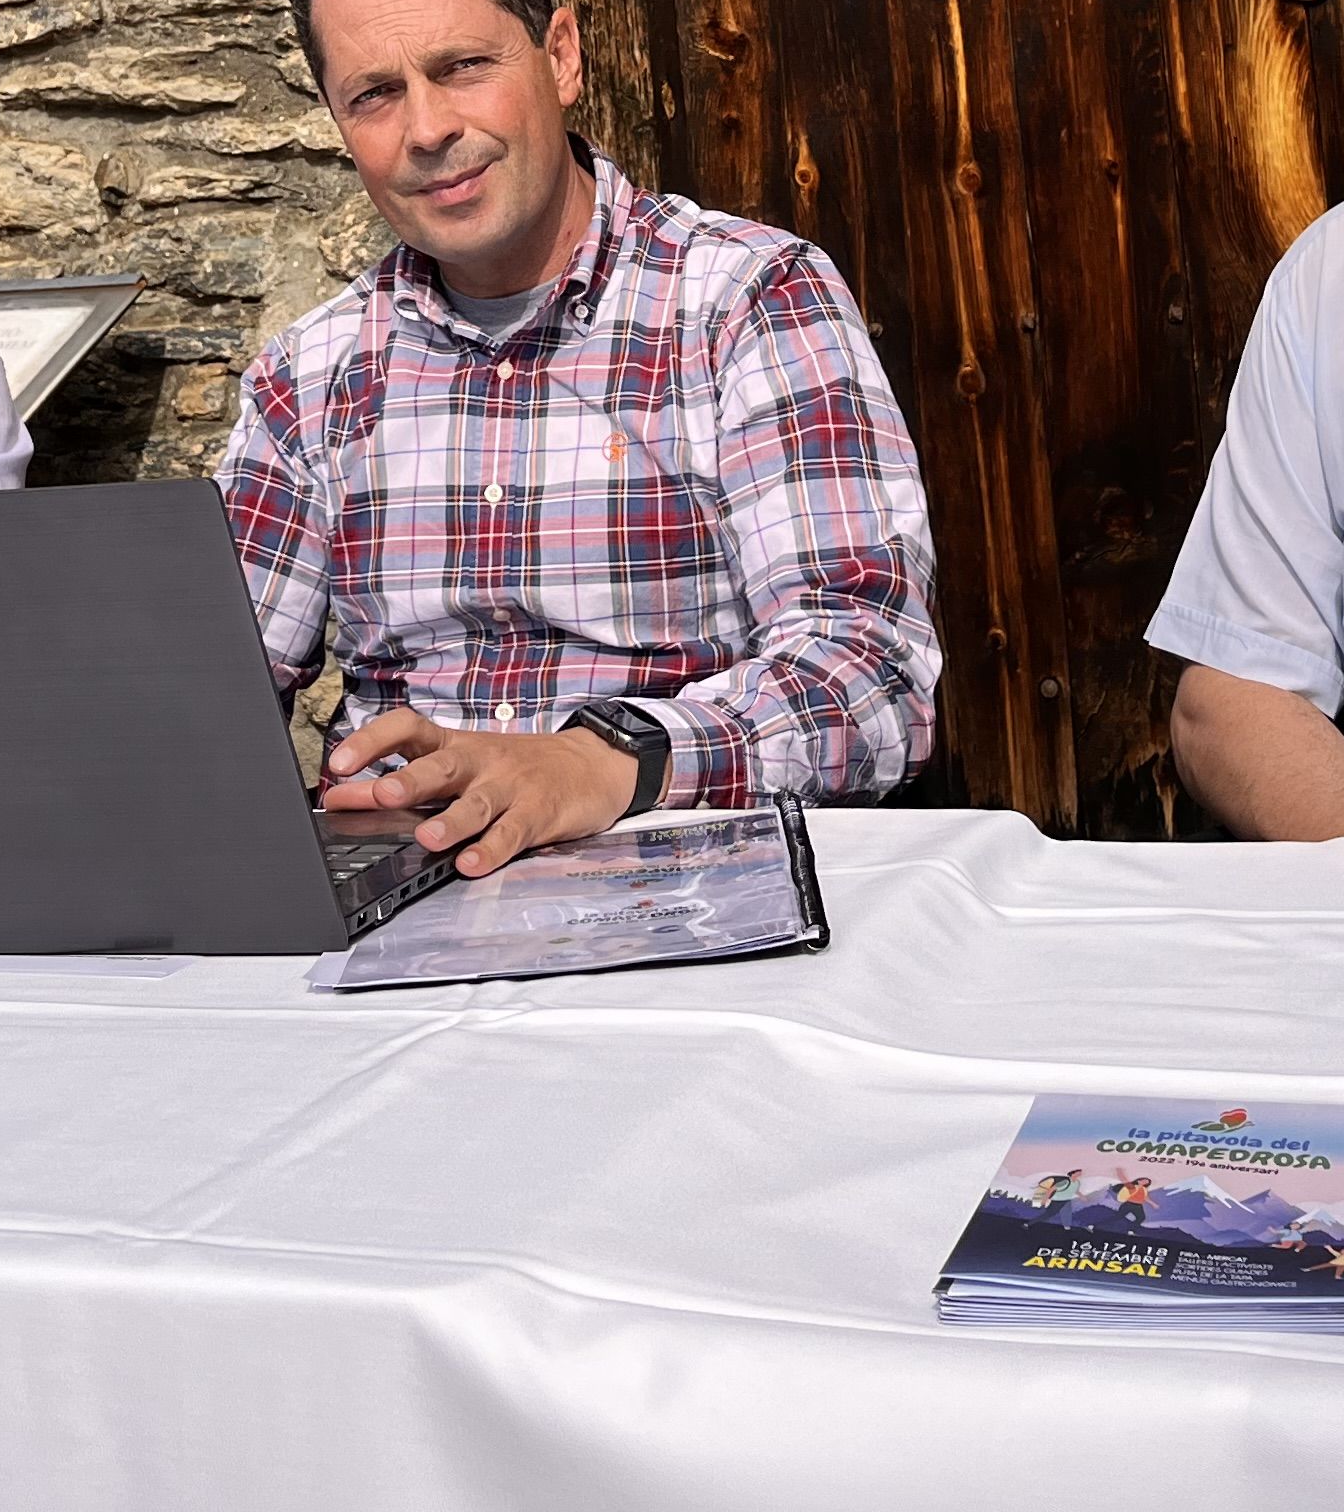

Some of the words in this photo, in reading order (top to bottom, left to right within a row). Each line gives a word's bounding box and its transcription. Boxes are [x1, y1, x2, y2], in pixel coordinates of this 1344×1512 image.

[1128, 1127, 1150, 1139] la
[1156, 1129, 1262, 1148] pitavola
[1270, 1137, 1311, 1151] del
[1096, 1139, 1332, 1170] COMAPEDROSA
[1138, 1155, 1175, 1165] 2022
[1022, 1256, 1163, 1278] ARINSAL
[1036, 1247, 1063, 1257] DE
[1068, 1249, 1166, 1267] SETEMBRE
